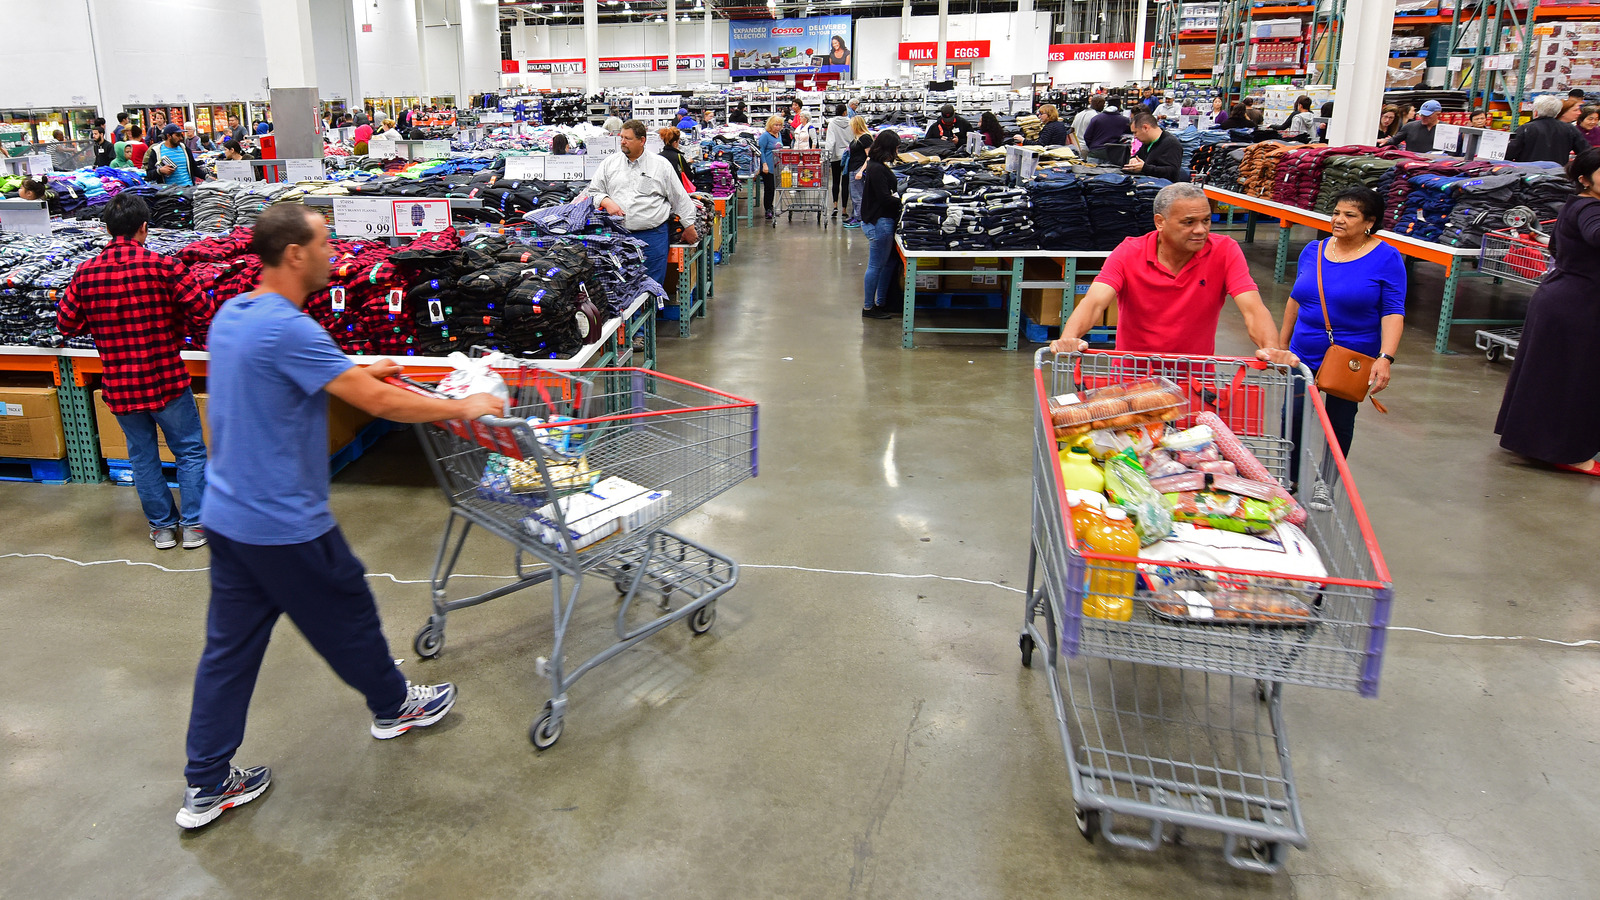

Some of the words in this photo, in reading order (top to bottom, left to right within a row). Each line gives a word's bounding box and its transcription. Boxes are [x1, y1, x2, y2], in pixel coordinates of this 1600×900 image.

[771, 27, 804, 35] COSTCO
[909, 49, 933, 59] MILK
[954, 48, 979, 58] EGGS
[1049, 52, 1065, 60] KES
[1073, 51, 1106, 60] KOSHER
[1108, 51, 1135, 60] BAKER
[553, 63, 580, 73] MEAT
[562, 172, 583, 180] 12.99
[365, 222, 390, 234] 9.99
